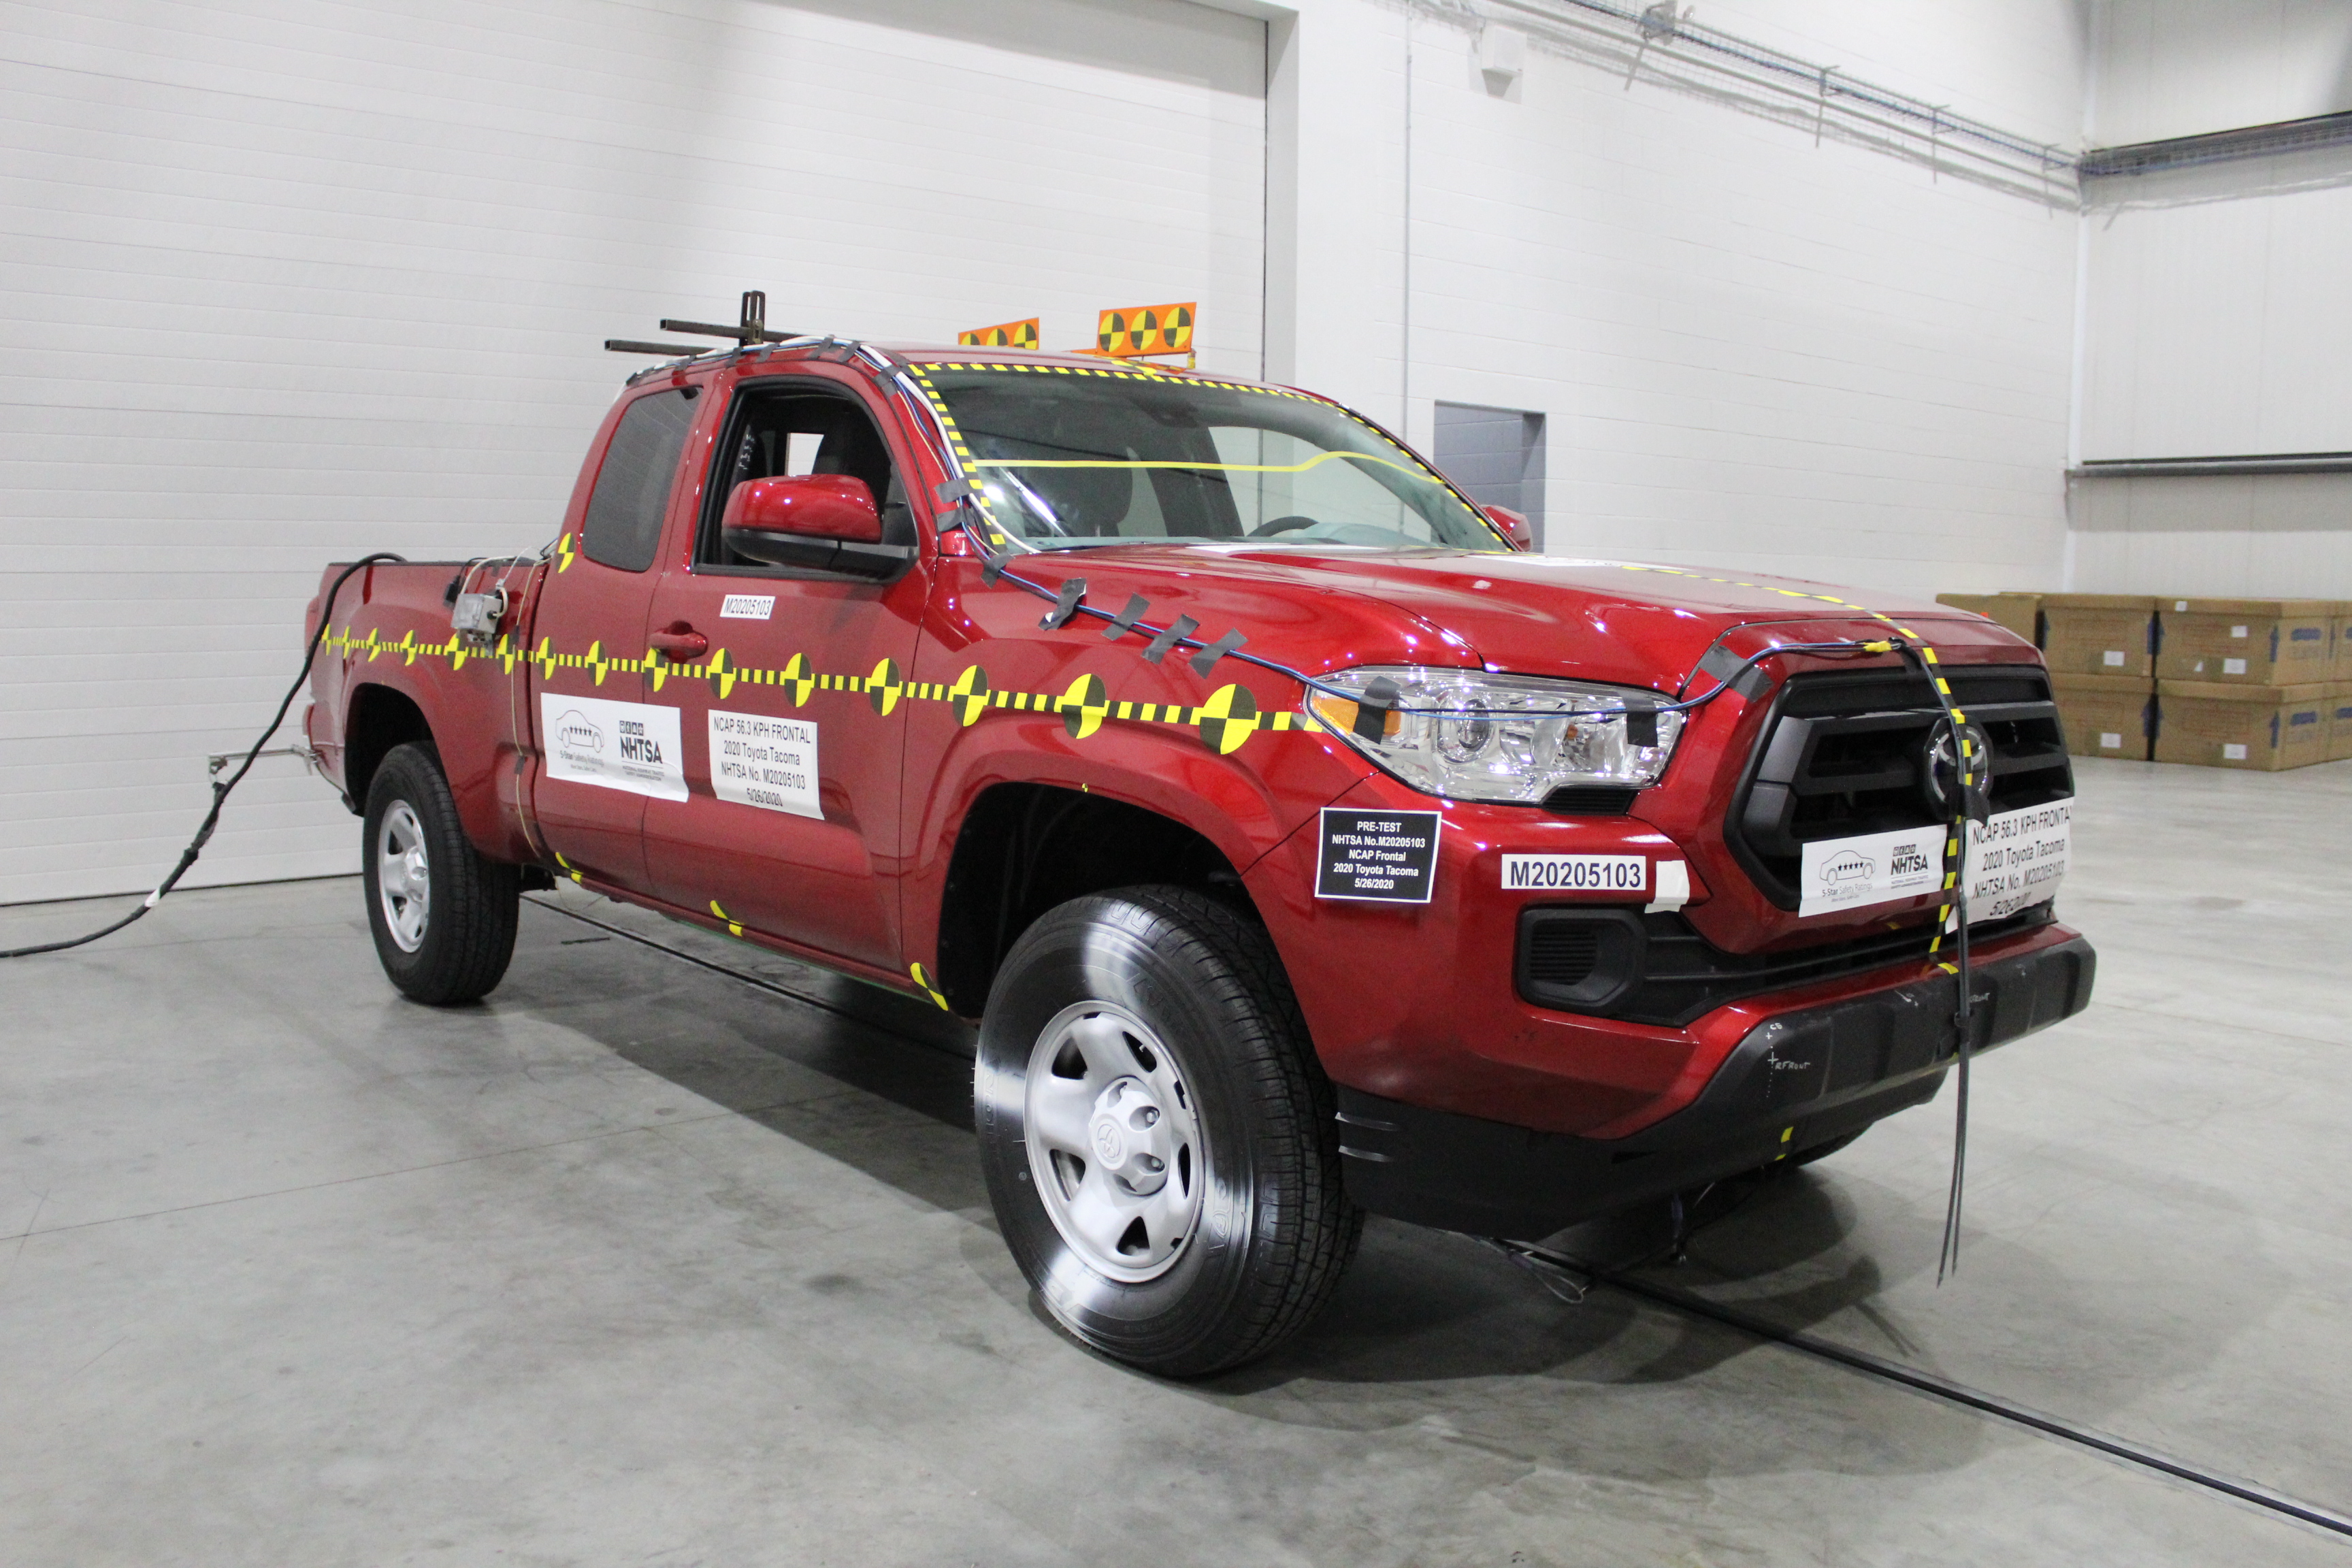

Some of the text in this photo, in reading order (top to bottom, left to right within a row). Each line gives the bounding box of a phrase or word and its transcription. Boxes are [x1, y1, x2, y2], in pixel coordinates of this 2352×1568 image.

[724, 598, 771, 615] M20205103
[714, 717, 811, 744] NCAP 56.3 KPH FRONTAL
[619, 736, 663, 764] NHTSA
[723, 740, 800, 766] 2020 Toyota Tacoma
[721, 761, 805, 789] NHTSA No. M20205103
[746, 787, 783, 806] 5/26/2020
[1356, 821, 1402, 832] PRE-TEST
[1973, 823, 1999, 845] NCAP
[2001, 819, 2018, 839] 56.3
[2021, 814, 2037, 835] KPH
[1332, 834, 1426, 848] NHTSA No.M20205103
[1348, 849, 1406, 862] NCAP Frontal
[1891, 853, 1928, 875] NHTSA
[1982, 838, 2065, 871] 2020 Toyota Tacoma
[1333, 862, 1419, 877] 2020 Toyota Tacoma
[1510, 861, 1641, 887] M20205103
[1972, 860, 2065, 900] NHTSA No. M20205103
[1354, 878, 1394, 889] 5/26/2020
[1822, 883, 1873, 897] 5-Star Safety Ratings
